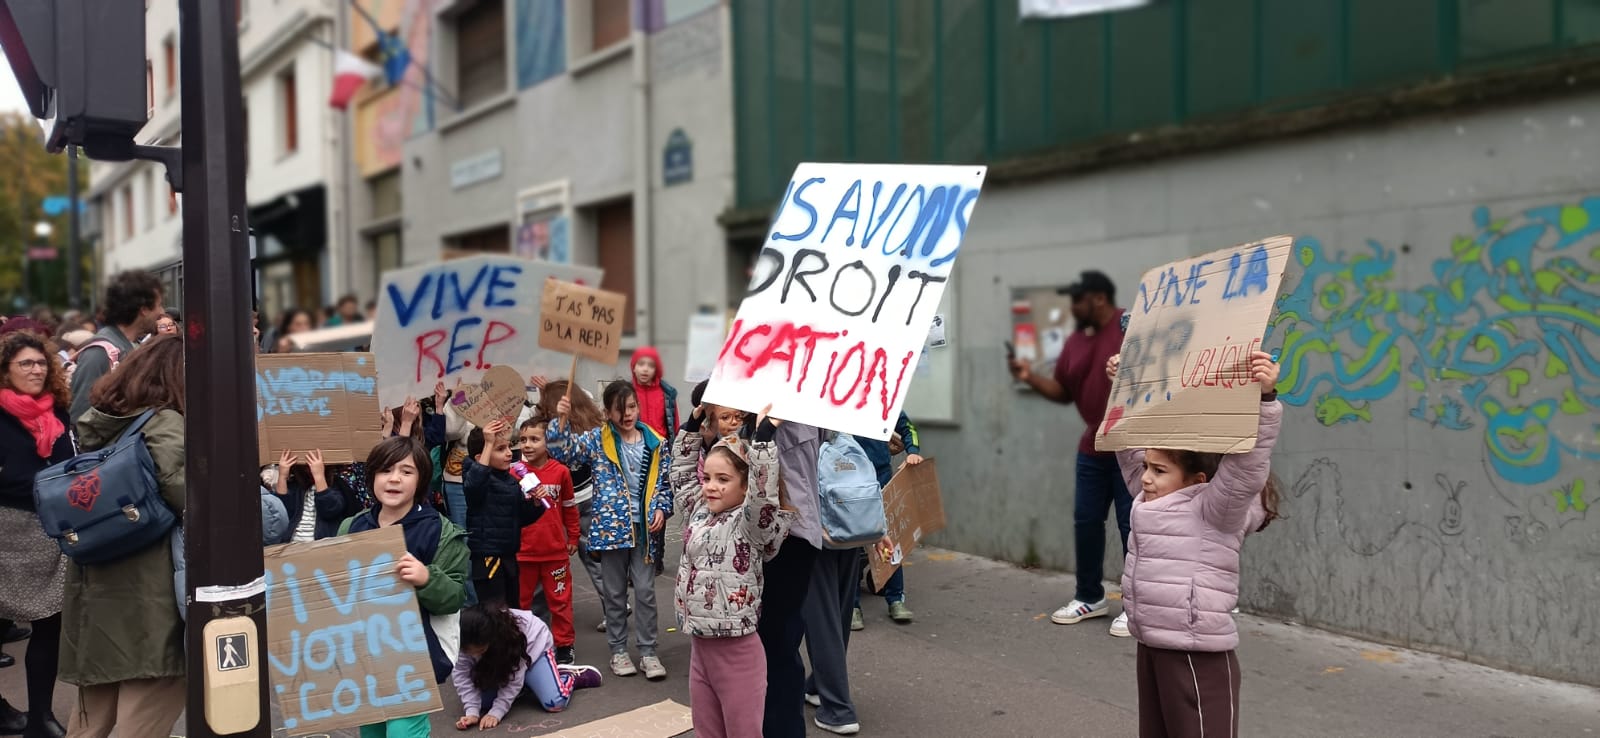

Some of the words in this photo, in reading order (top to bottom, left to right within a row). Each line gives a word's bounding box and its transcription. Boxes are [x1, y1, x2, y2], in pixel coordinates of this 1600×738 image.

[820, 179, 980, 268] AVONS
[387, 263, 523, 328] VIVE
[747, 247, 947, 326] DROIT
[1222, 244, 1269, 300] LA
[556, 322, 572, 340] LA
[591, 304, 615, 325] PAS
